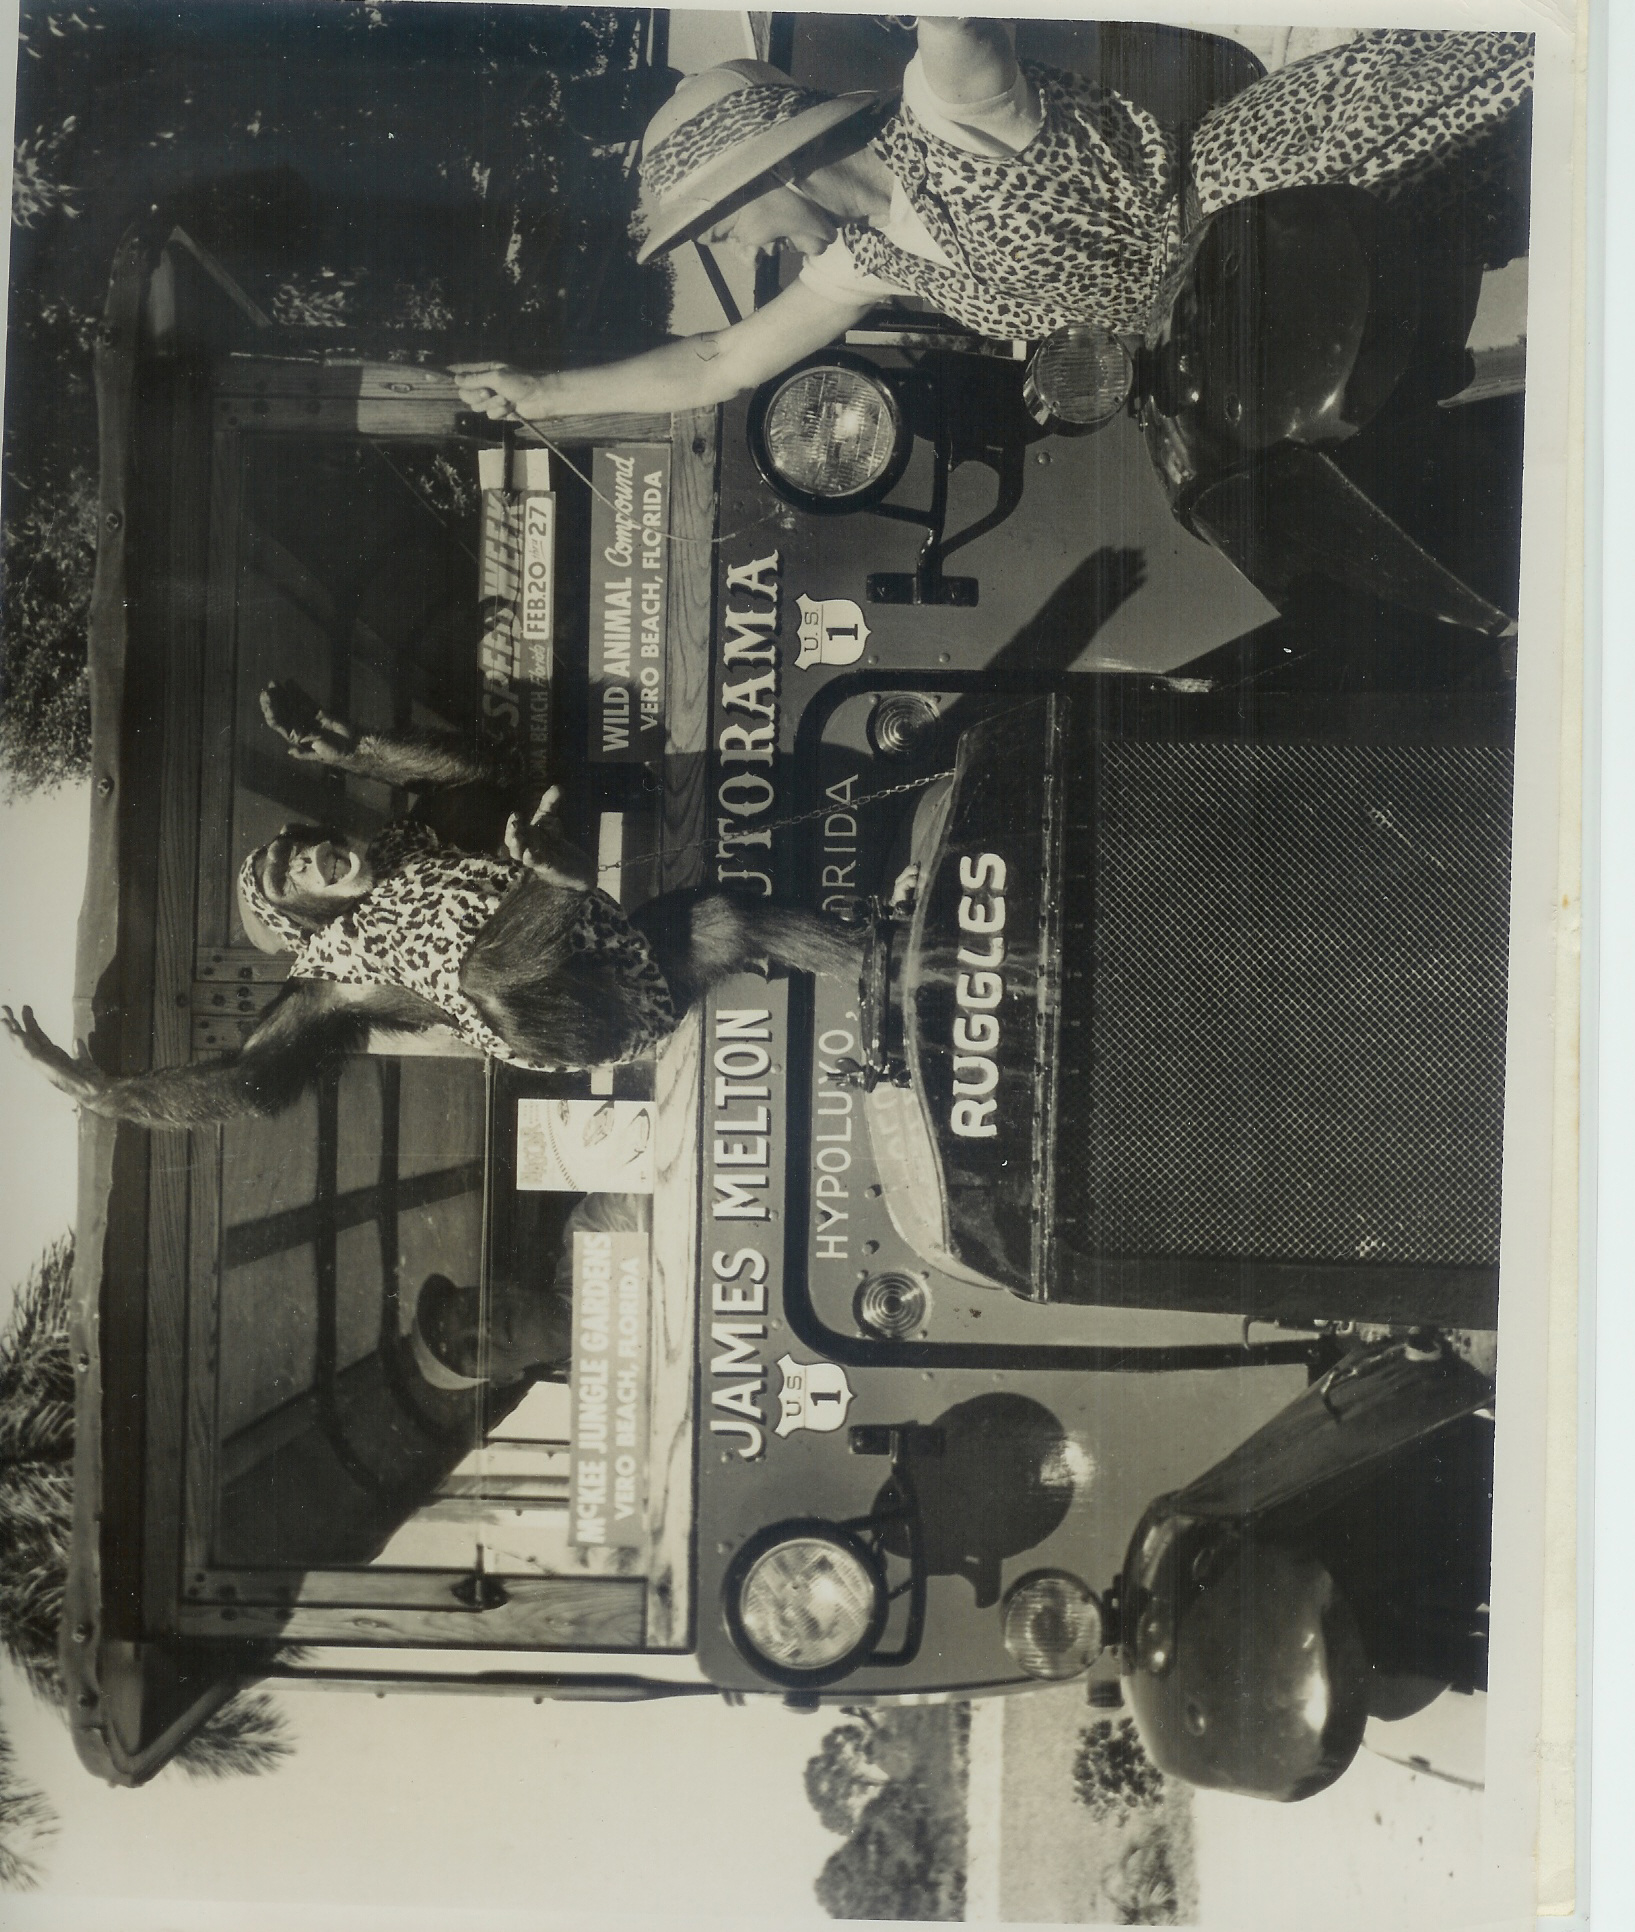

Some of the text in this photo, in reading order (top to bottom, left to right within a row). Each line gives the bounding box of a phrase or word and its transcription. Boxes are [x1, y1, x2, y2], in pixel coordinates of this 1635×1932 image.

[528, 506, 547, 536] 27
[482, 491, 524, 727] SPEED WEEK
[602, 452, 639, 752] WILD ANIMAL Compound
[639, 470, 663, 731] VERO BEACH, FLORIDA
[825, 624, 859, 641] 1
[528, 644, 547, 687] Florida
[529, 691, 548, 742] BEACH
[821, 773, 859, 910] RIDA
[710, 549, 779, 1457] JAMES MELTON UTORAMA
[950, 852, 1007, 1137] RUGGLES
[580, 1234, 612, 1352] GARDENS
[578, 1359, 609, 1454] JUNGLE
[615, 1258, 640, 1520] VERO BEACH, FLORIDA
[810, 1390, 841, 1406] 1
